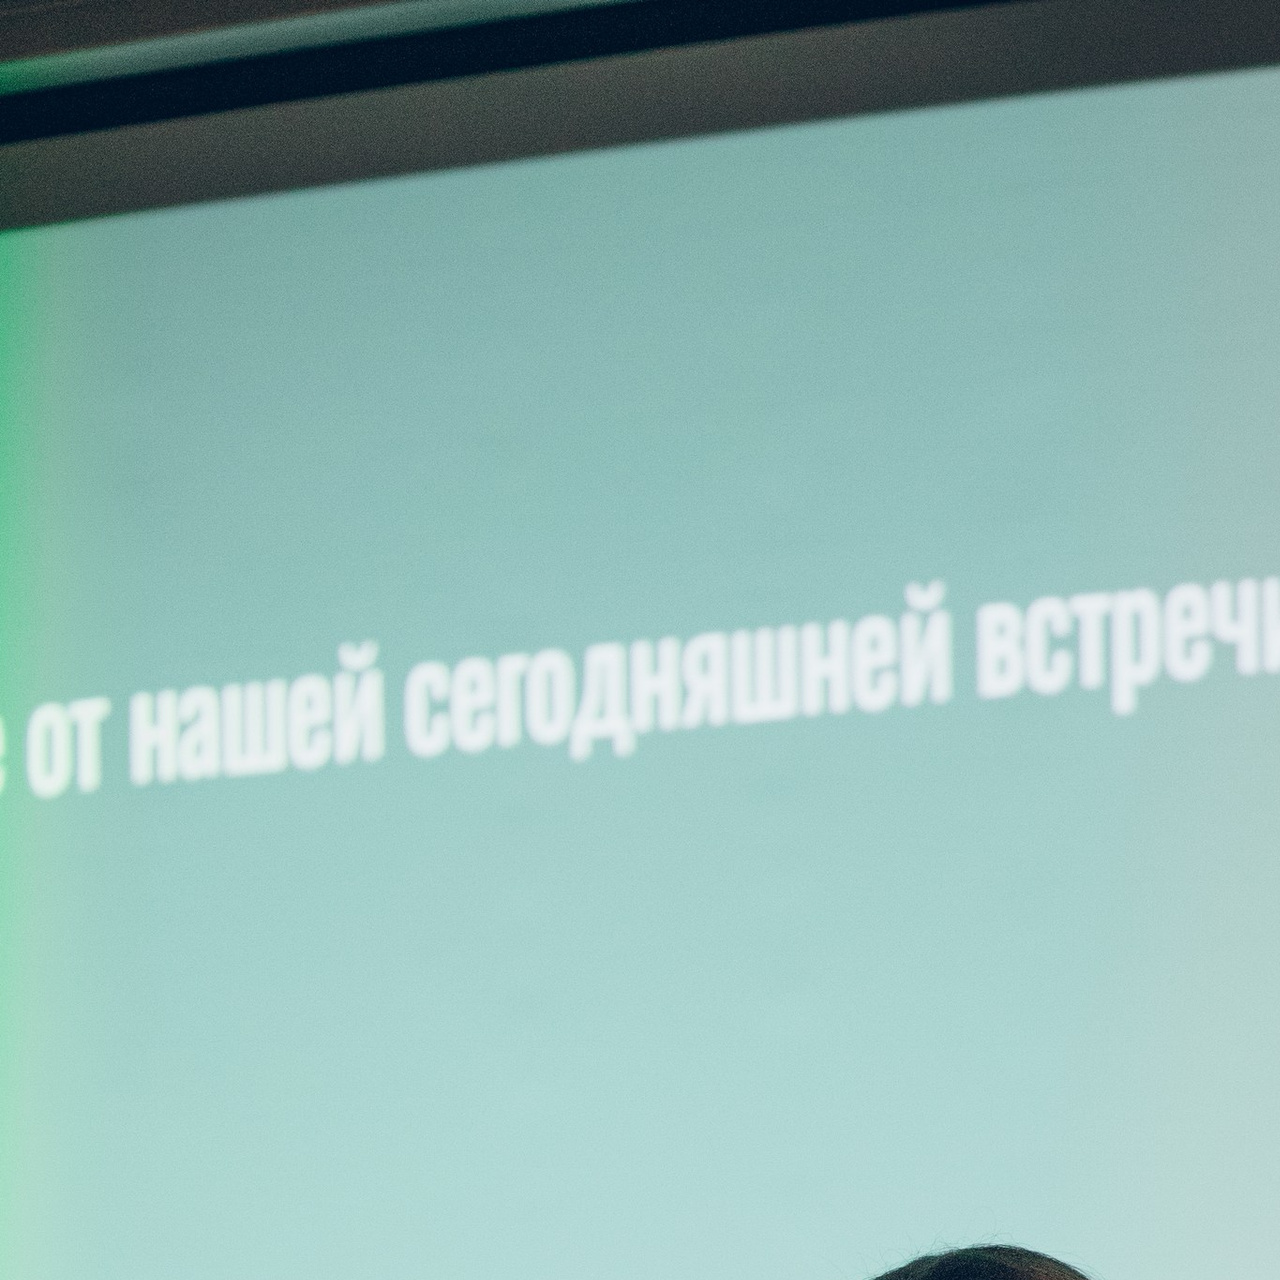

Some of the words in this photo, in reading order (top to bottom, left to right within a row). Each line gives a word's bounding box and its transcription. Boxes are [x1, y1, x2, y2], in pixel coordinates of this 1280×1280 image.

[27, 697, 111, 797] от
[129, 640, 384, 785] нашей
[404, 580, 952, 761] сегодняшней
